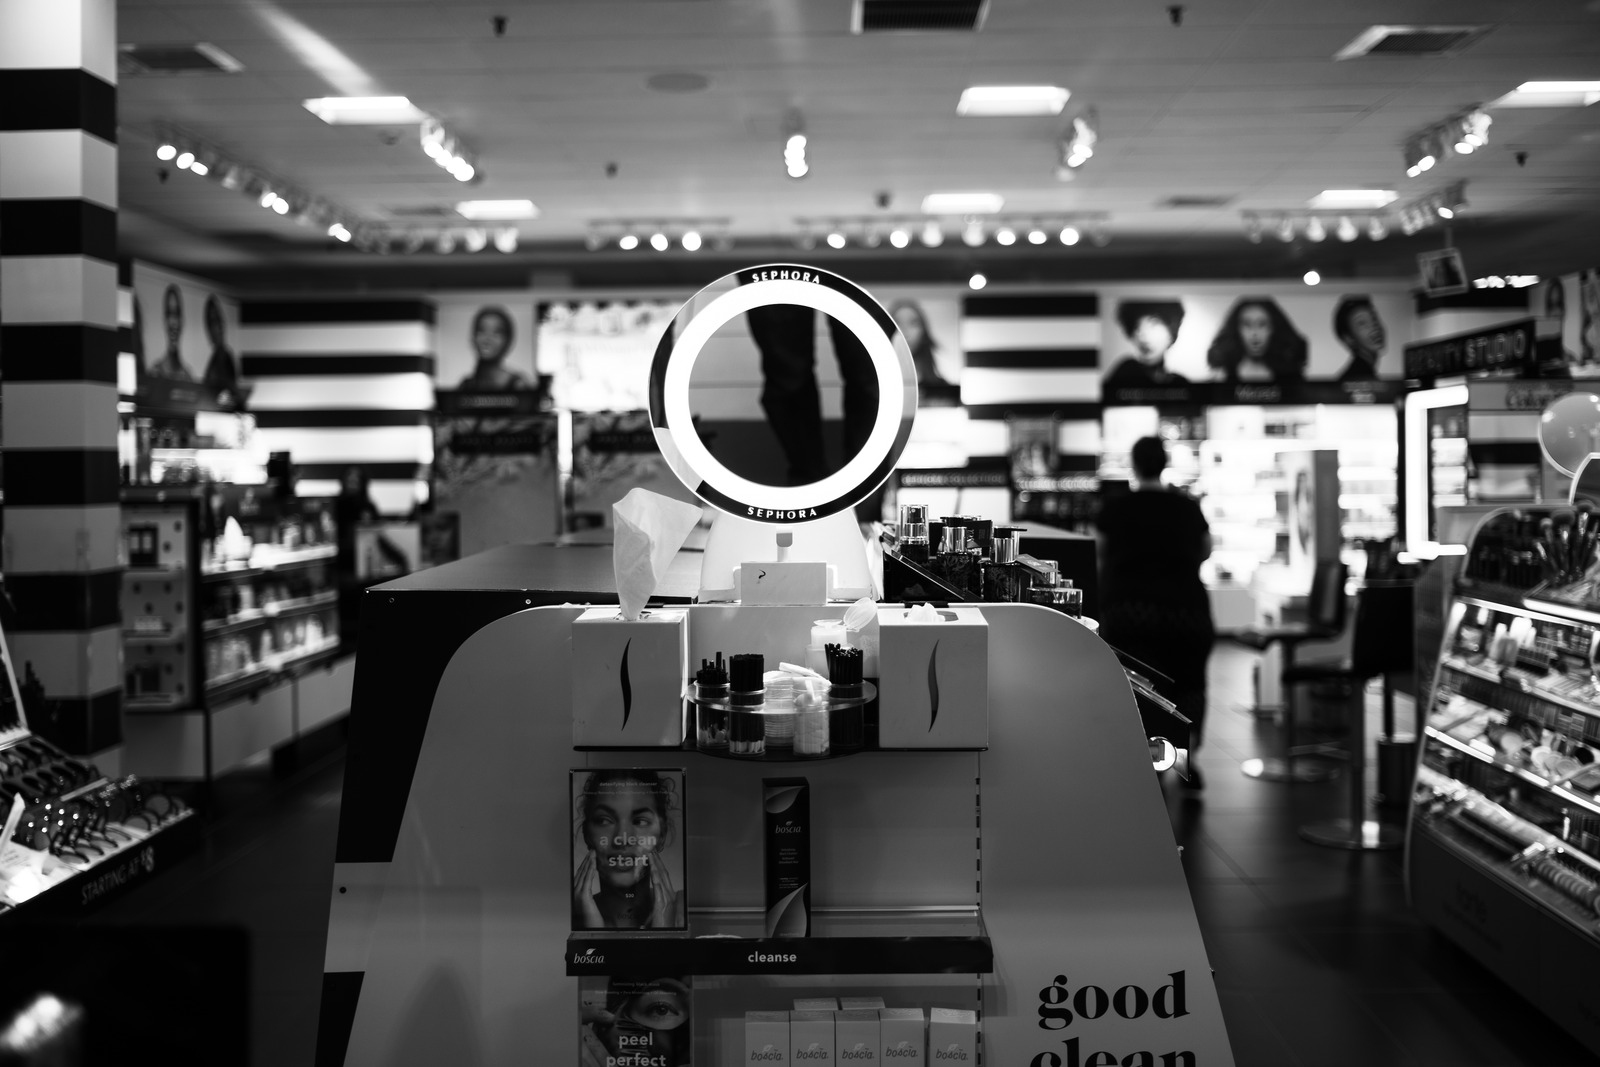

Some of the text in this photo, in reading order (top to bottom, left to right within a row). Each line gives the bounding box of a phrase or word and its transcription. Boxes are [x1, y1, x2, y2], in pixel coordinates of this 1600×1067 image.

[752, 270, 820, 284] SEPHORA
[1464, 329, 1527, 368] STUDIO
[747, 506, 817, 520] SEPHORA
[775, 824, 802, 834] boscia
[599, 832, 657, 846] a clean
[608, 854, 649, 867] start
[81, 864, 127, 906] STARTING
[573, 952, 605, 964] boscia
[747, 951, 797, 963] cleanse
[1037, 969, 1191, 1030] good
[618, 1031, 653, 1049] peel
[606, 1052, 667, 1067] perfect
